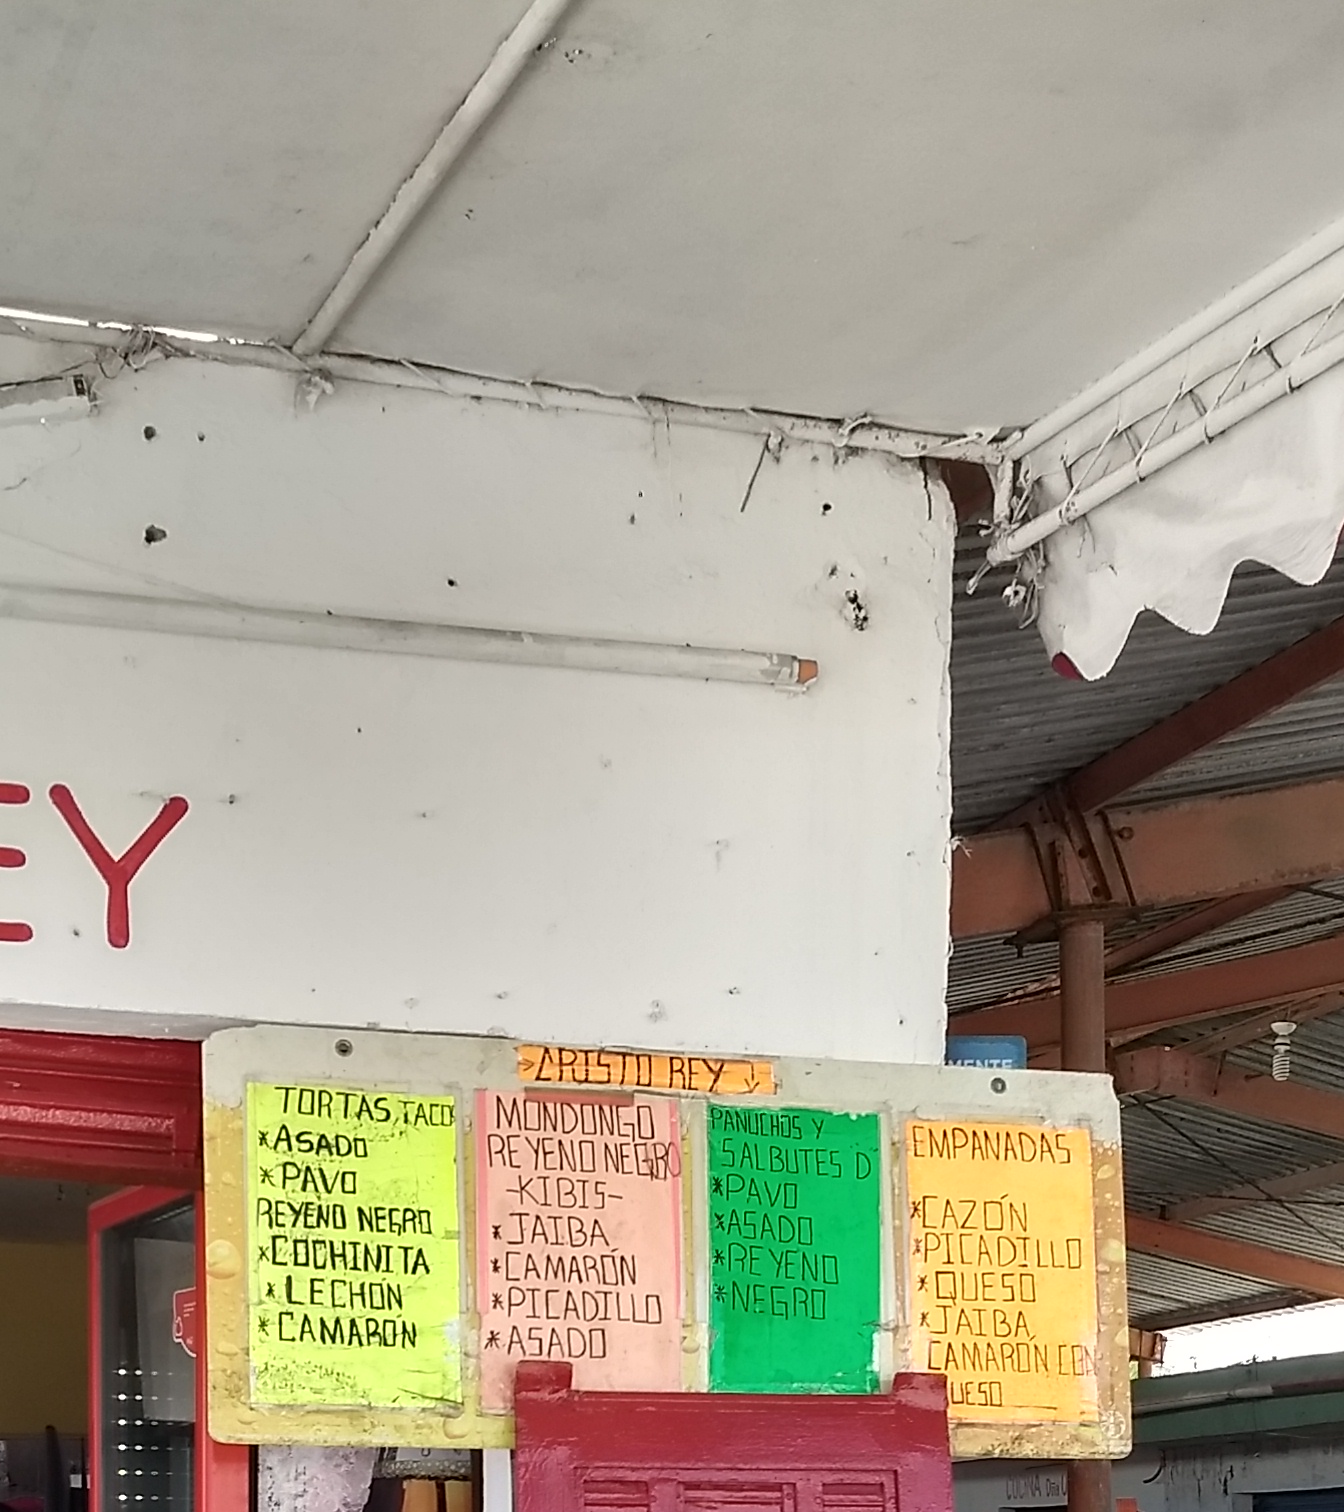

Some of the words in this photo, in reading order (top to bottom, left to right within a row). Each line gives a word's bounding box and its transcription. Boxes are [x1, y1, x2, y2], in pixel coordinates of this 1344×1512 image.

[535, 1048, 653, 1087] CRISTO
[669, 1056, 725, 1092] REY
[495, 1095, 656, 1142] MONDONGO
[710, 1107, 803, 1140] PANUCHOS
[811, 1118, 825, 1140] Y
[273, 1124, 369, 1158] ASADO
[487, 1134, 596, 1174] REYENO
[604, 1140, 683, 1182] NEGRO
[721, 1138, 842, 1178] SALBUTES
[912, 1125, 1072, 1164] EMPANADAS
[282, 1162, 357, 1195] PAVO
[726, 1174, 798, 1209] PAVO
[257, 1197, 347, 1230] REYENO
[357, 1206, 433, 1237] NEGRO
[506, 1212, 610, 1249] JAIBA
[727, 1208, 813, 1245] ASADO
[922, 1193, 1028, 1232] CAZÓN
[271, 1235, 431, 1275] COCHINITA
[505, 1248, 637, 1287] CAMARÓN
[728, 1242, 839, 1285] REYENO
[923, 1231, 1083, 1269] PICADILLO
[507, 1286, 663, 1325] PICADILLO
[732, 1280, 826, 1320] NEGRO
[934, 1270, 1036, 1307] QUESO
[930, 1305, 1030, 1338] JAIBA
[507, 1325, 607, 1360] ASADO
[928, 1335, 1049, 1376] CAMARÓN
[951, 1381, 1004, 1408] UESO
